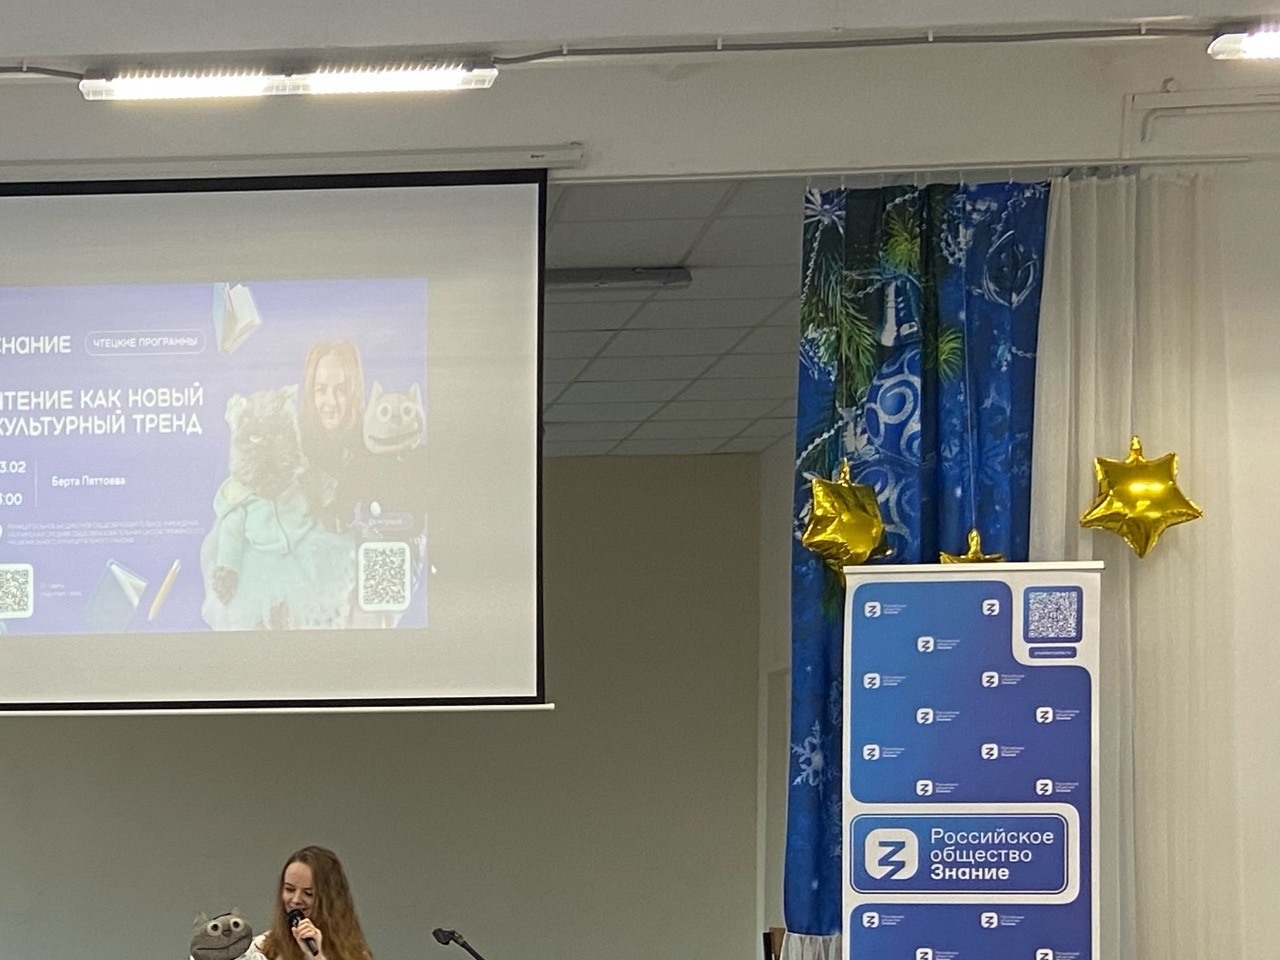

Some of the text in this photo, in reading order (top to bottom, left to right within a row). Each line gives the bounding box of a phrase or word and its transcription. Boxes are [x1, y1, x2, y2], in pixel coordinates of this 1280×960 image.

[93, 336, 198, 349] ЧТЕЦКИЕ ПРОГРАММЫ
[80, 388, 122, 409] КАК
[128, 381, 204, 408] НОВЫЙ
[132, 413, 203, 435] ТРЕНД
[51, 475, 81, 488] Берта
[930, 827, 1054, 844] Российское
[930, 845, 1032, 864] общество
[930, 863, 1010, 880] Знание
